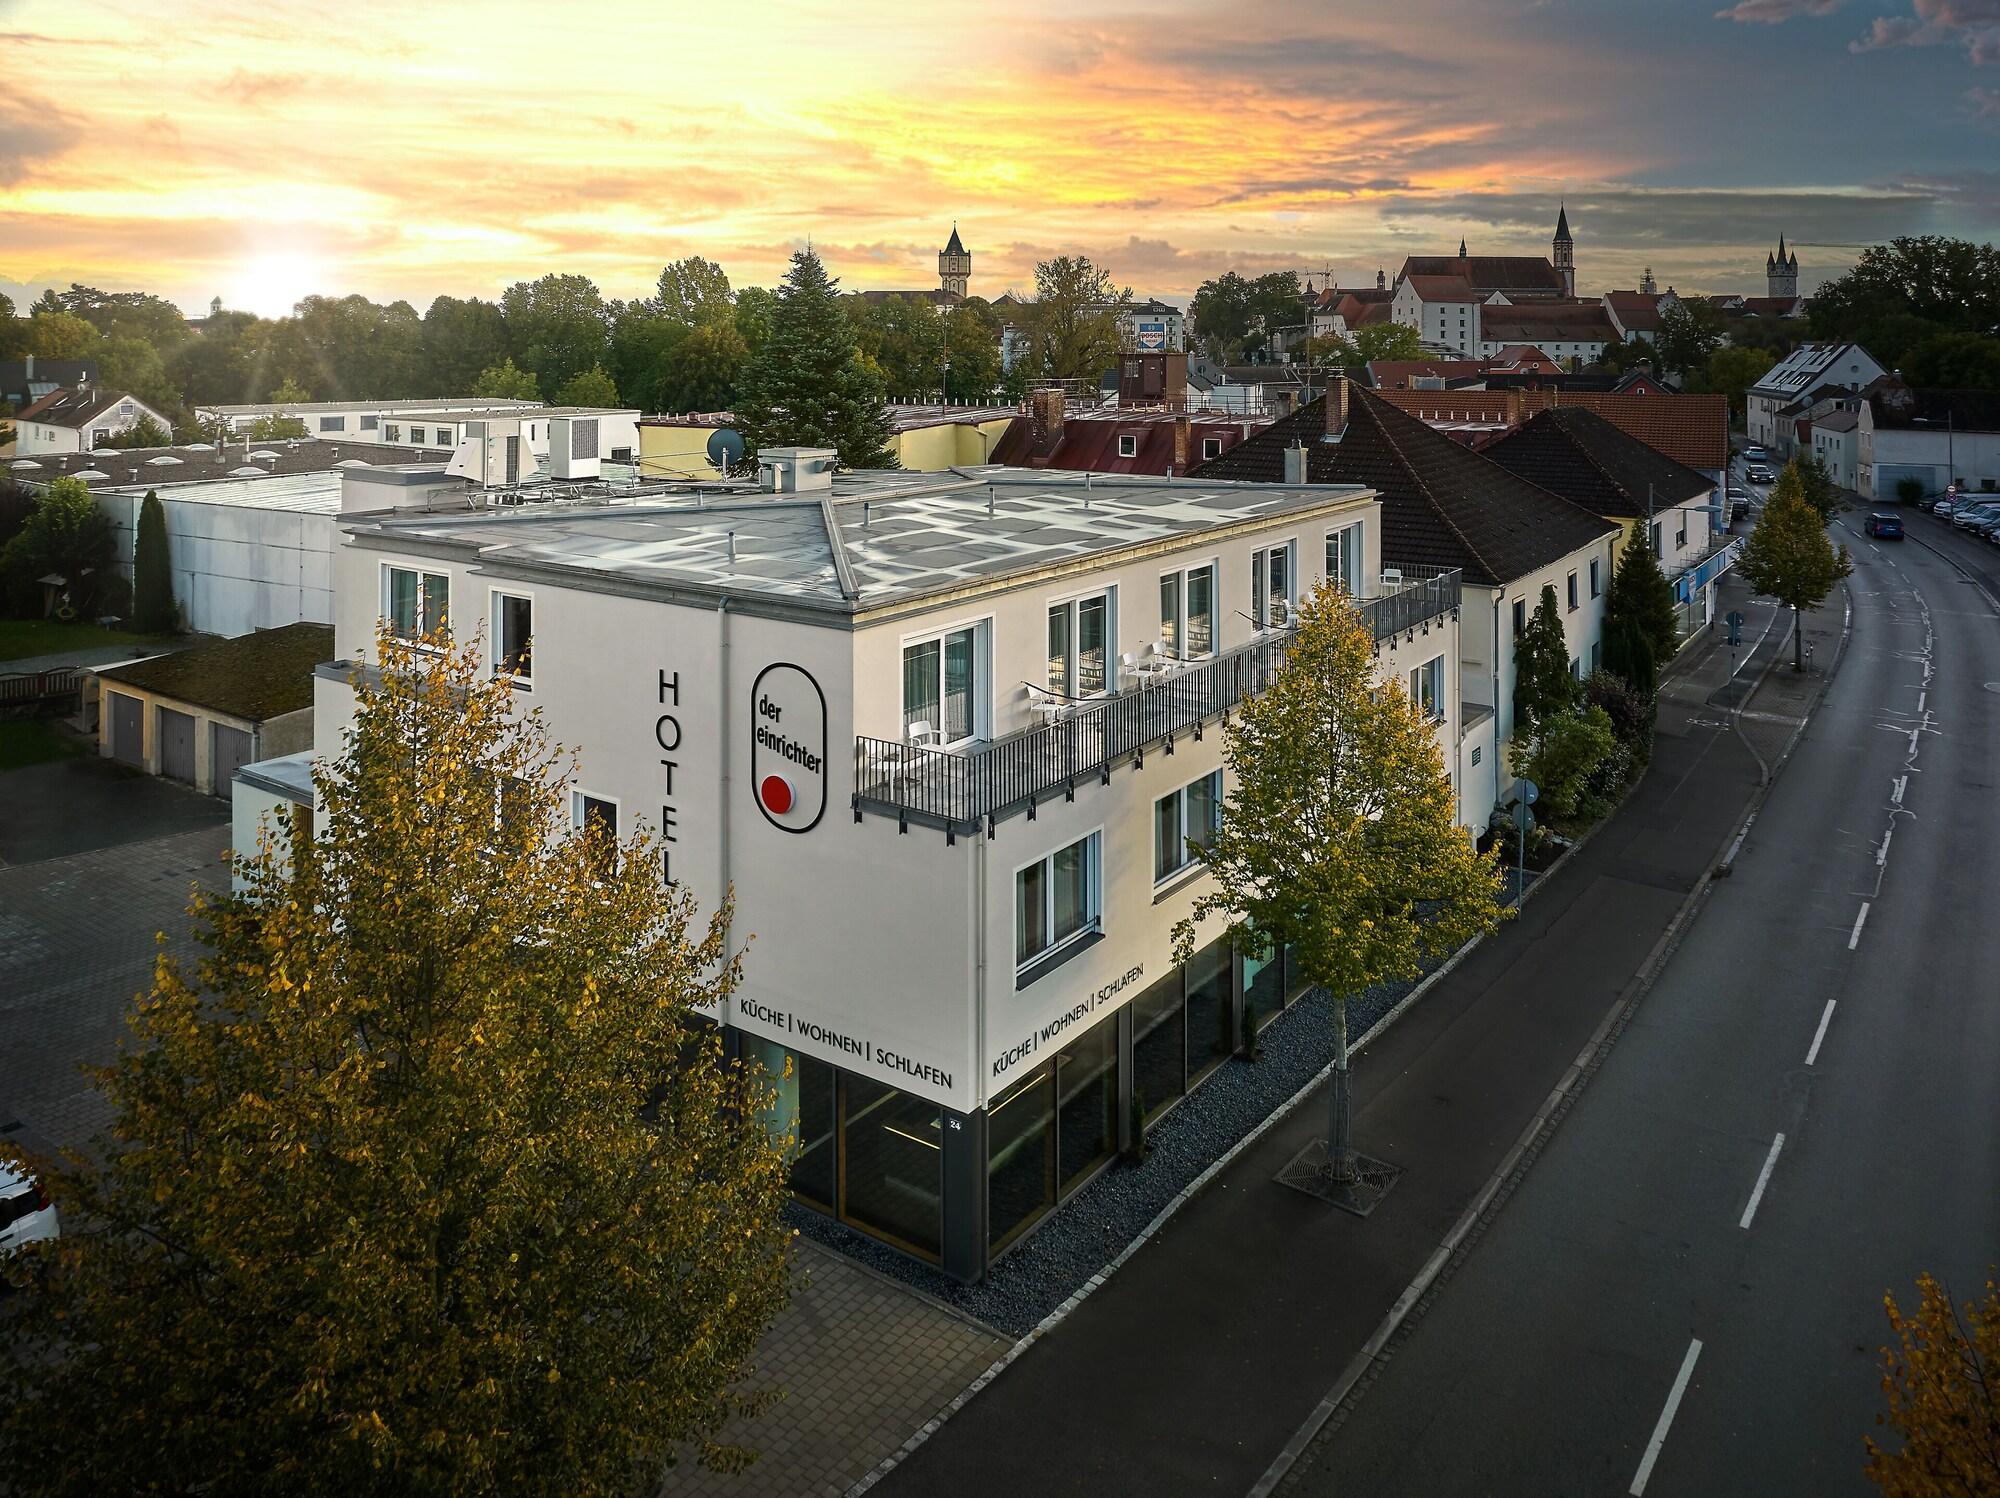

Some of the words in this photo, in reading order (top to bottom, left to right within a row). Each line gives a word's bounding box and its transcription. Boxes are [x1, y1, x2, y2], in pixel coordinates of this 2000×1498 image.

[759, 694, 782, 723] der
[655, 669, 682, 888] HOTEL
[757, 725, 822, 774] einrichter
[740, 998, 785, 1028] KÜCHE
[797, 1019, 862, 1056] WOHNEN
[876, 1048, 953, 1089] SCHLAFEN
[992, 1038, 1032, 1077] KÜCHE
[1041, 999, 1089, 1043] WOHNEN
[1098, 962, 1145, 1005] SCHLAFEN
[950, 1120, 961, 1130] 24
